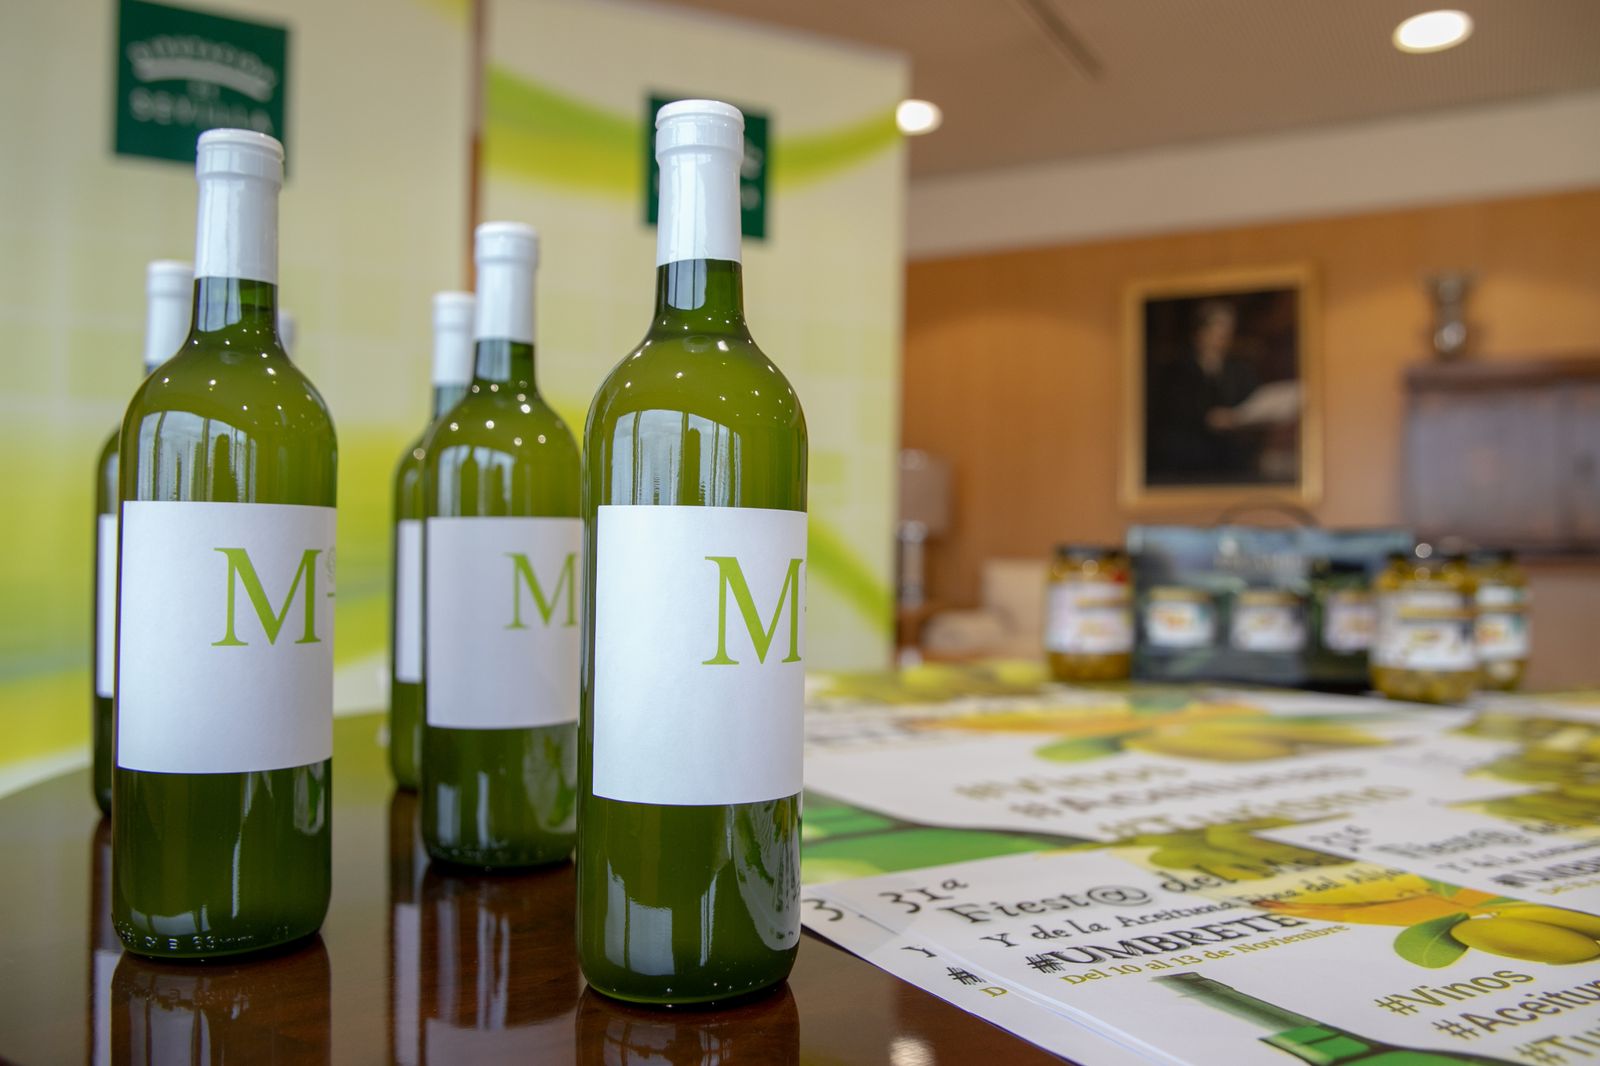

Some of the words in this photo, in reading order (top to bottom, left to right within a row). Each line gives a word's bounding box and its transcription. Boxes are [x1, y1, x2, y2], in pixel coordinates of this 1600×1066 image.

[211, 547, 322, 646] M
[504, 552, 579, 630] M
[702, 555, 804, 666] M
[936, 885, 1152, 923] Fiest@
[1157, 864, 1239, 894] del
[979, 932, 1019, 948] Y
[1030, 924, 1072, 940] de
[1064, 919, 1111, 934] la
[1025, 912, 1309, 974] #UMBRETE
[1059, 963, 1112, 985] Del
[1107, 963, 1142, 975] 10
[1145, 953, 1173, 970] al
[1169, 953, 1205, 967] 13
[1203, 949, 1237, 960] de
[1232, 922, 1353, 955] Noviembre
[1373, 970, 1535, 1017] #Vinos
